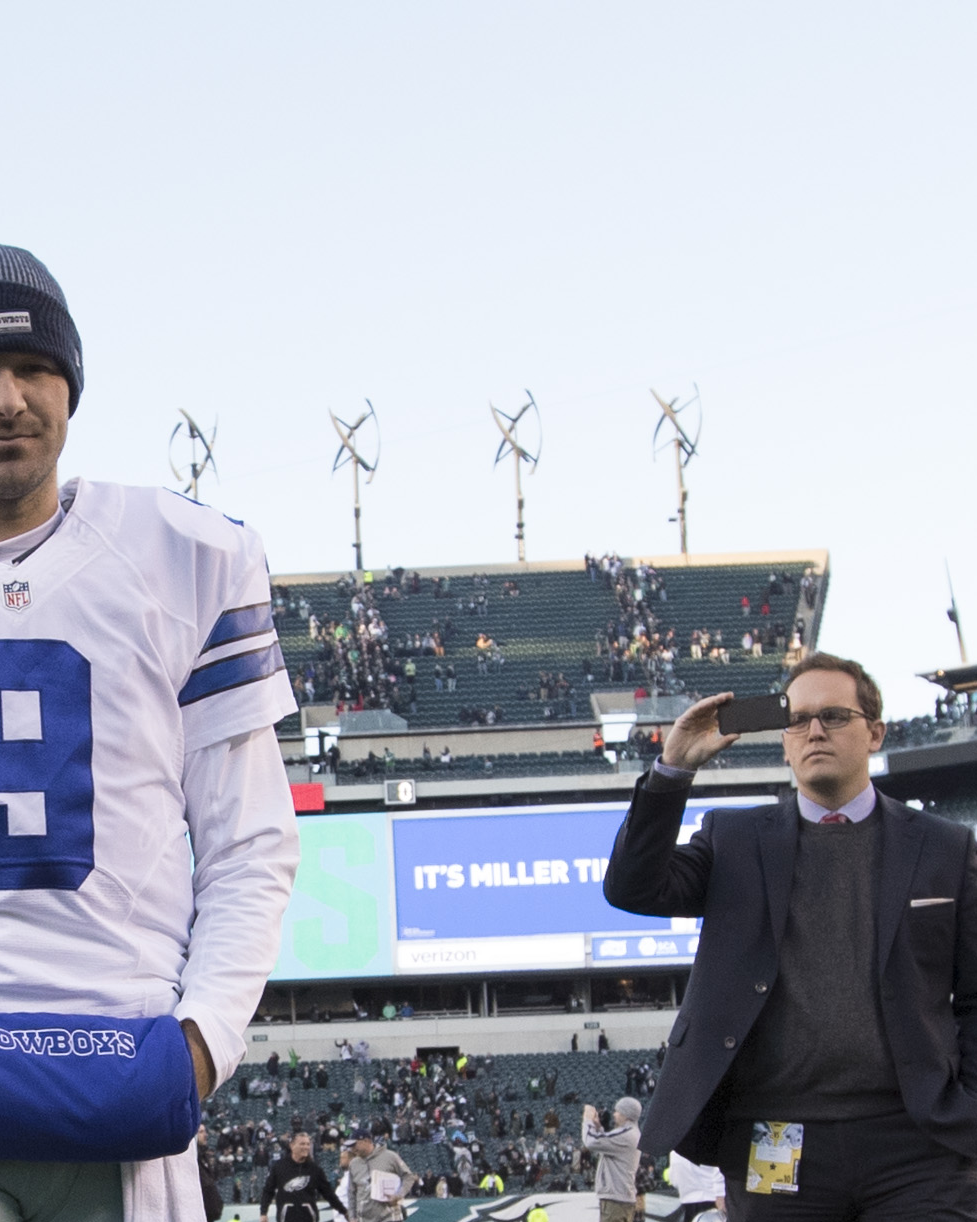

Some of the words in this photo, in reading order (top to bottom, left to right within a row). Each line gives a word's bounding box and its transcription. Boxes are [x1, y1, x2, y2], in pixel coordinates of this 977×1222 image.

[7, 592, 29, 607] NFL
[414, 863, 465, 890] IT'S
[469, 859, 570, 888] MILLER
[410, 945, 477, 964] verizon
